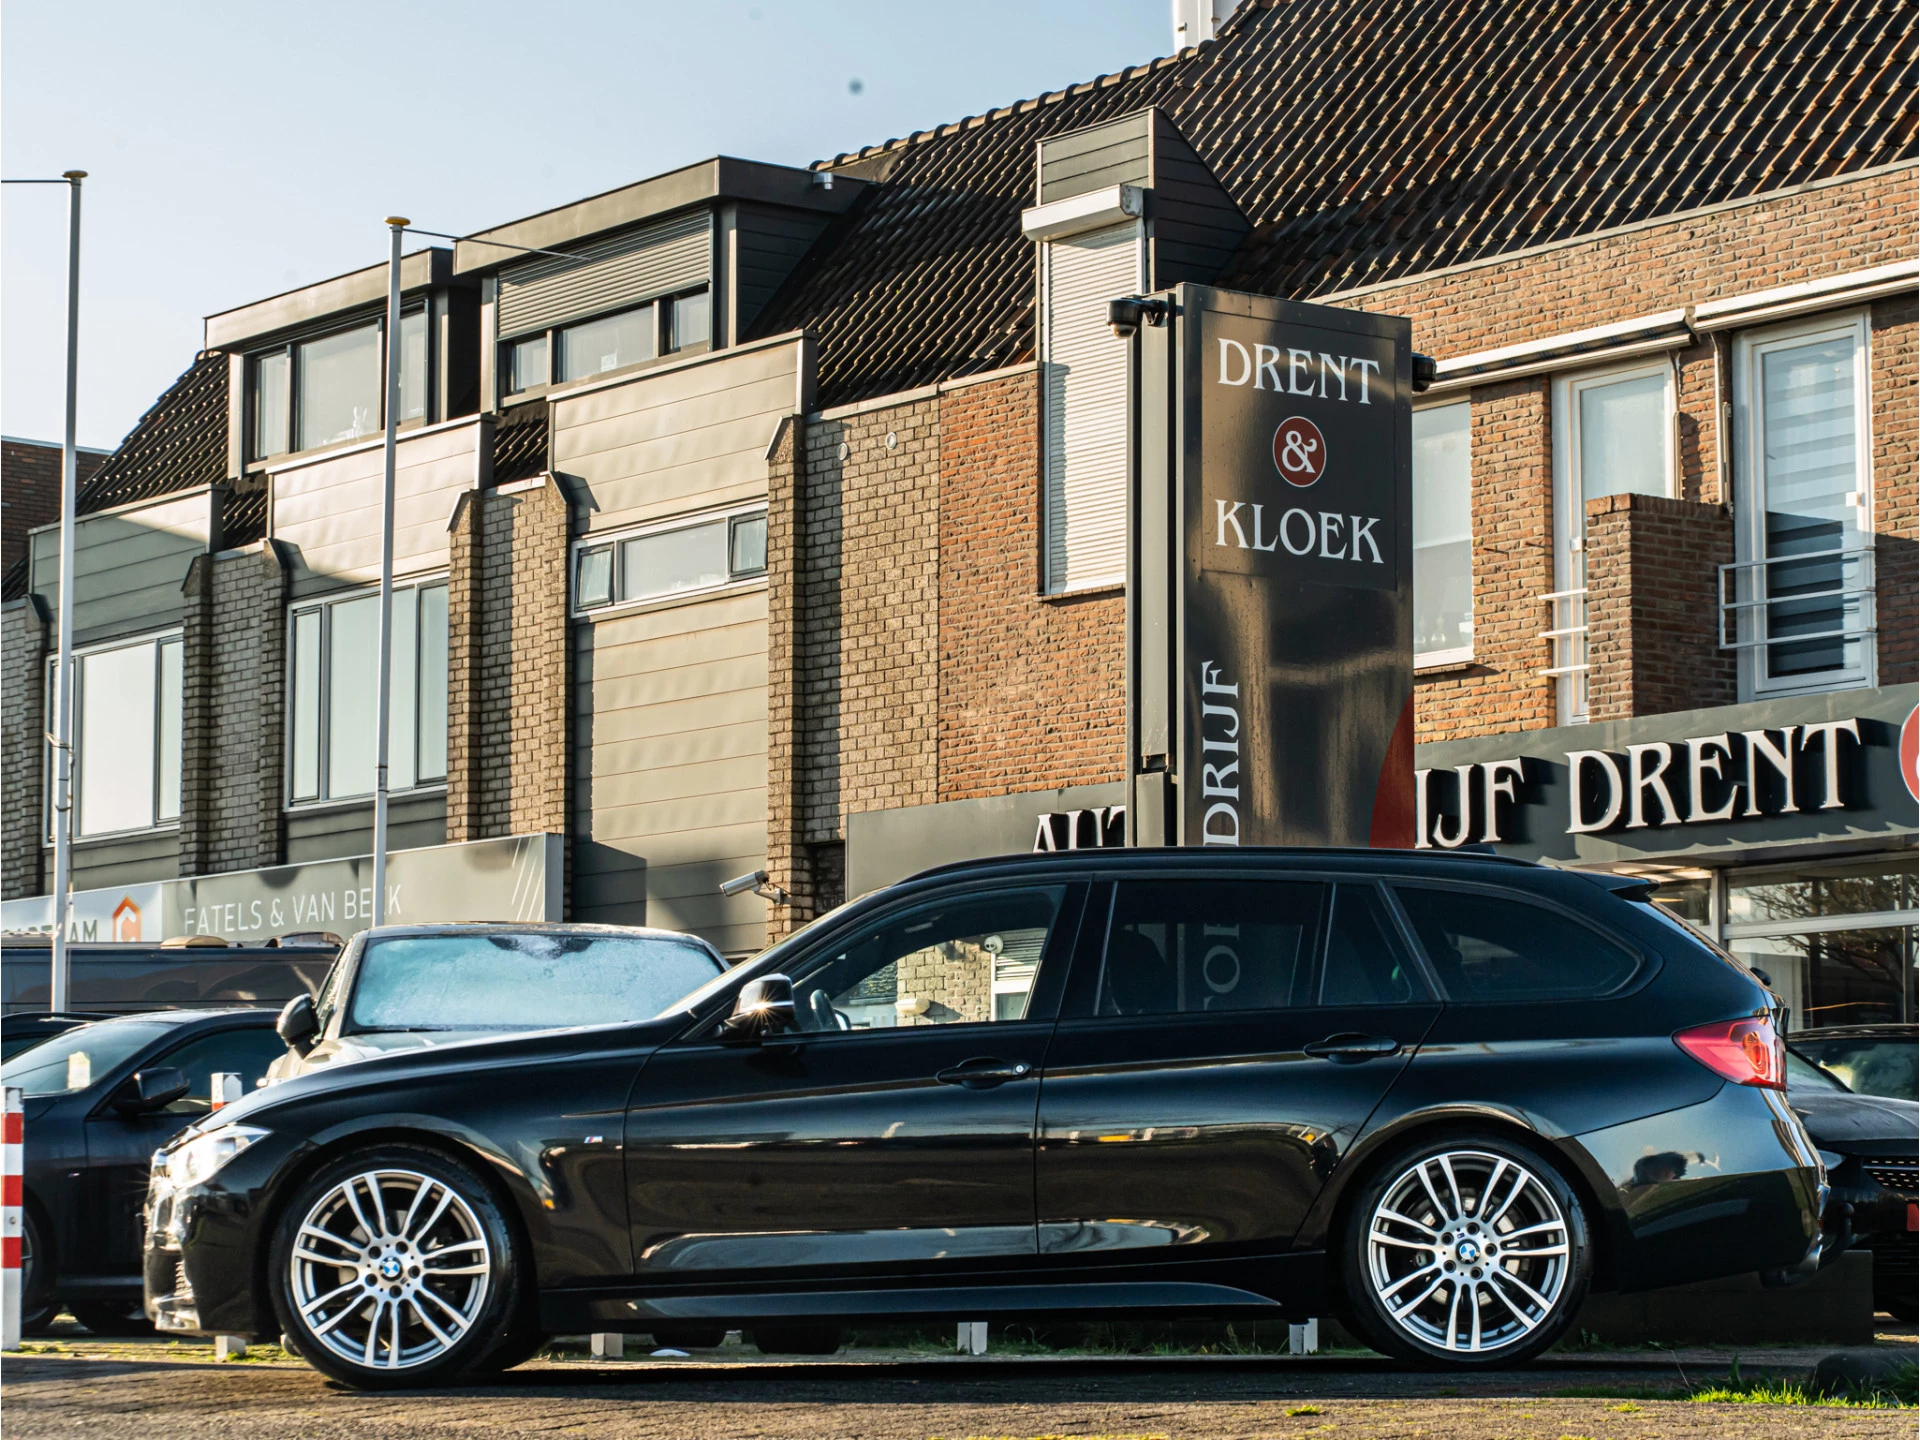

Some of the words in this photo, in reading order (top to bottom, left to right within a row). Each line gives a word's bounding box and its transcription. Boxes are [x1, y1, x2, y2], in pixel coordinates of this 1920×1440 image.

[1217, 337, 1381, 405] DRENT
[1281, 429, 1318, 474] &
[1214, 499, 1385, 564] KLOEK
[1564, 717, 1861, 835] DRENT
[270, 897, 285, 928] &
[292, 891, 335, 925] VAN
[344, 884, 402, 920] BEK
